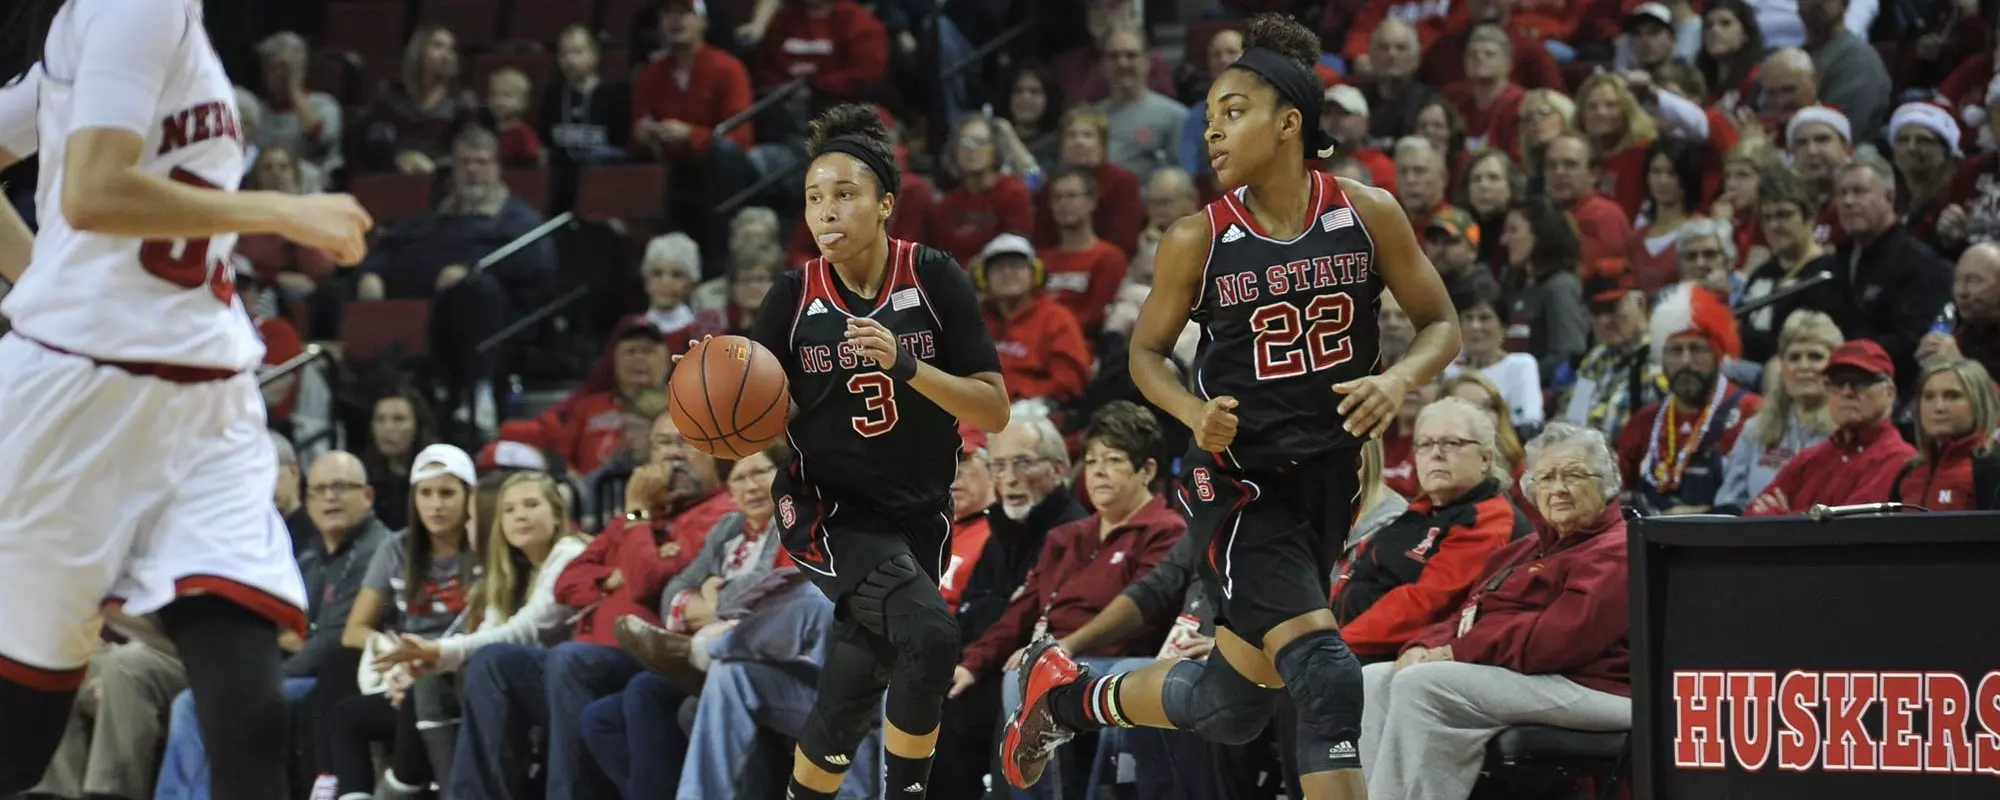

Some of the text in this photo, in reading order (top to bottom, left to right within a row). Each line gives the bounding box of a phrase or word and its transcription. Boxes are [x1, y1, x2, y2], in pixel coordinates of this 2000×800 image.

[1216, 252, 1369, 307] NC STATE
[800, 330, 936, 373] NC STE
[1249, 292, 1355, 381] 22
[847, 371, 899, 438] 3
[1672, 669, 2000, 774] HUSKERS
